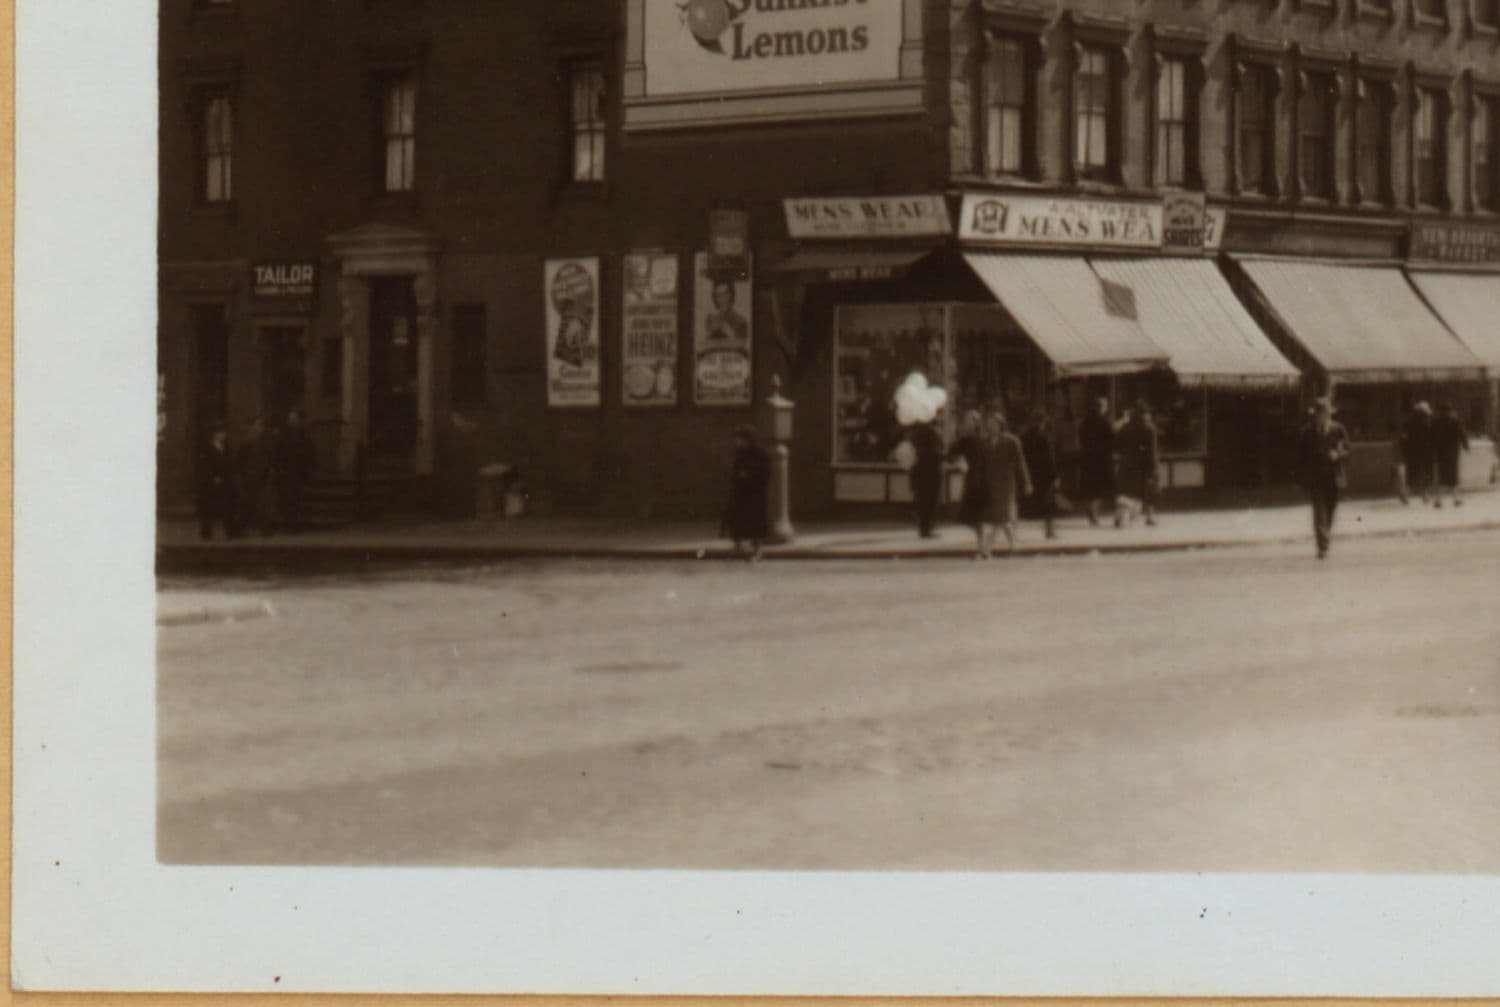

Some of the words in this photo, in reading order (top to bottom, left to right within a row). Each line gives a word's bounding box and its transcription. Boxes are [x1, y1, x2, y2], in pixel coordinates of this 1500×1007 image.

[730, 22, 870, 61] Lemons
[1017, 215, 1091, 237] MENS
[1100, 219, 1156, 241] WEA
[254, 265, 314, 284] TAILOR
